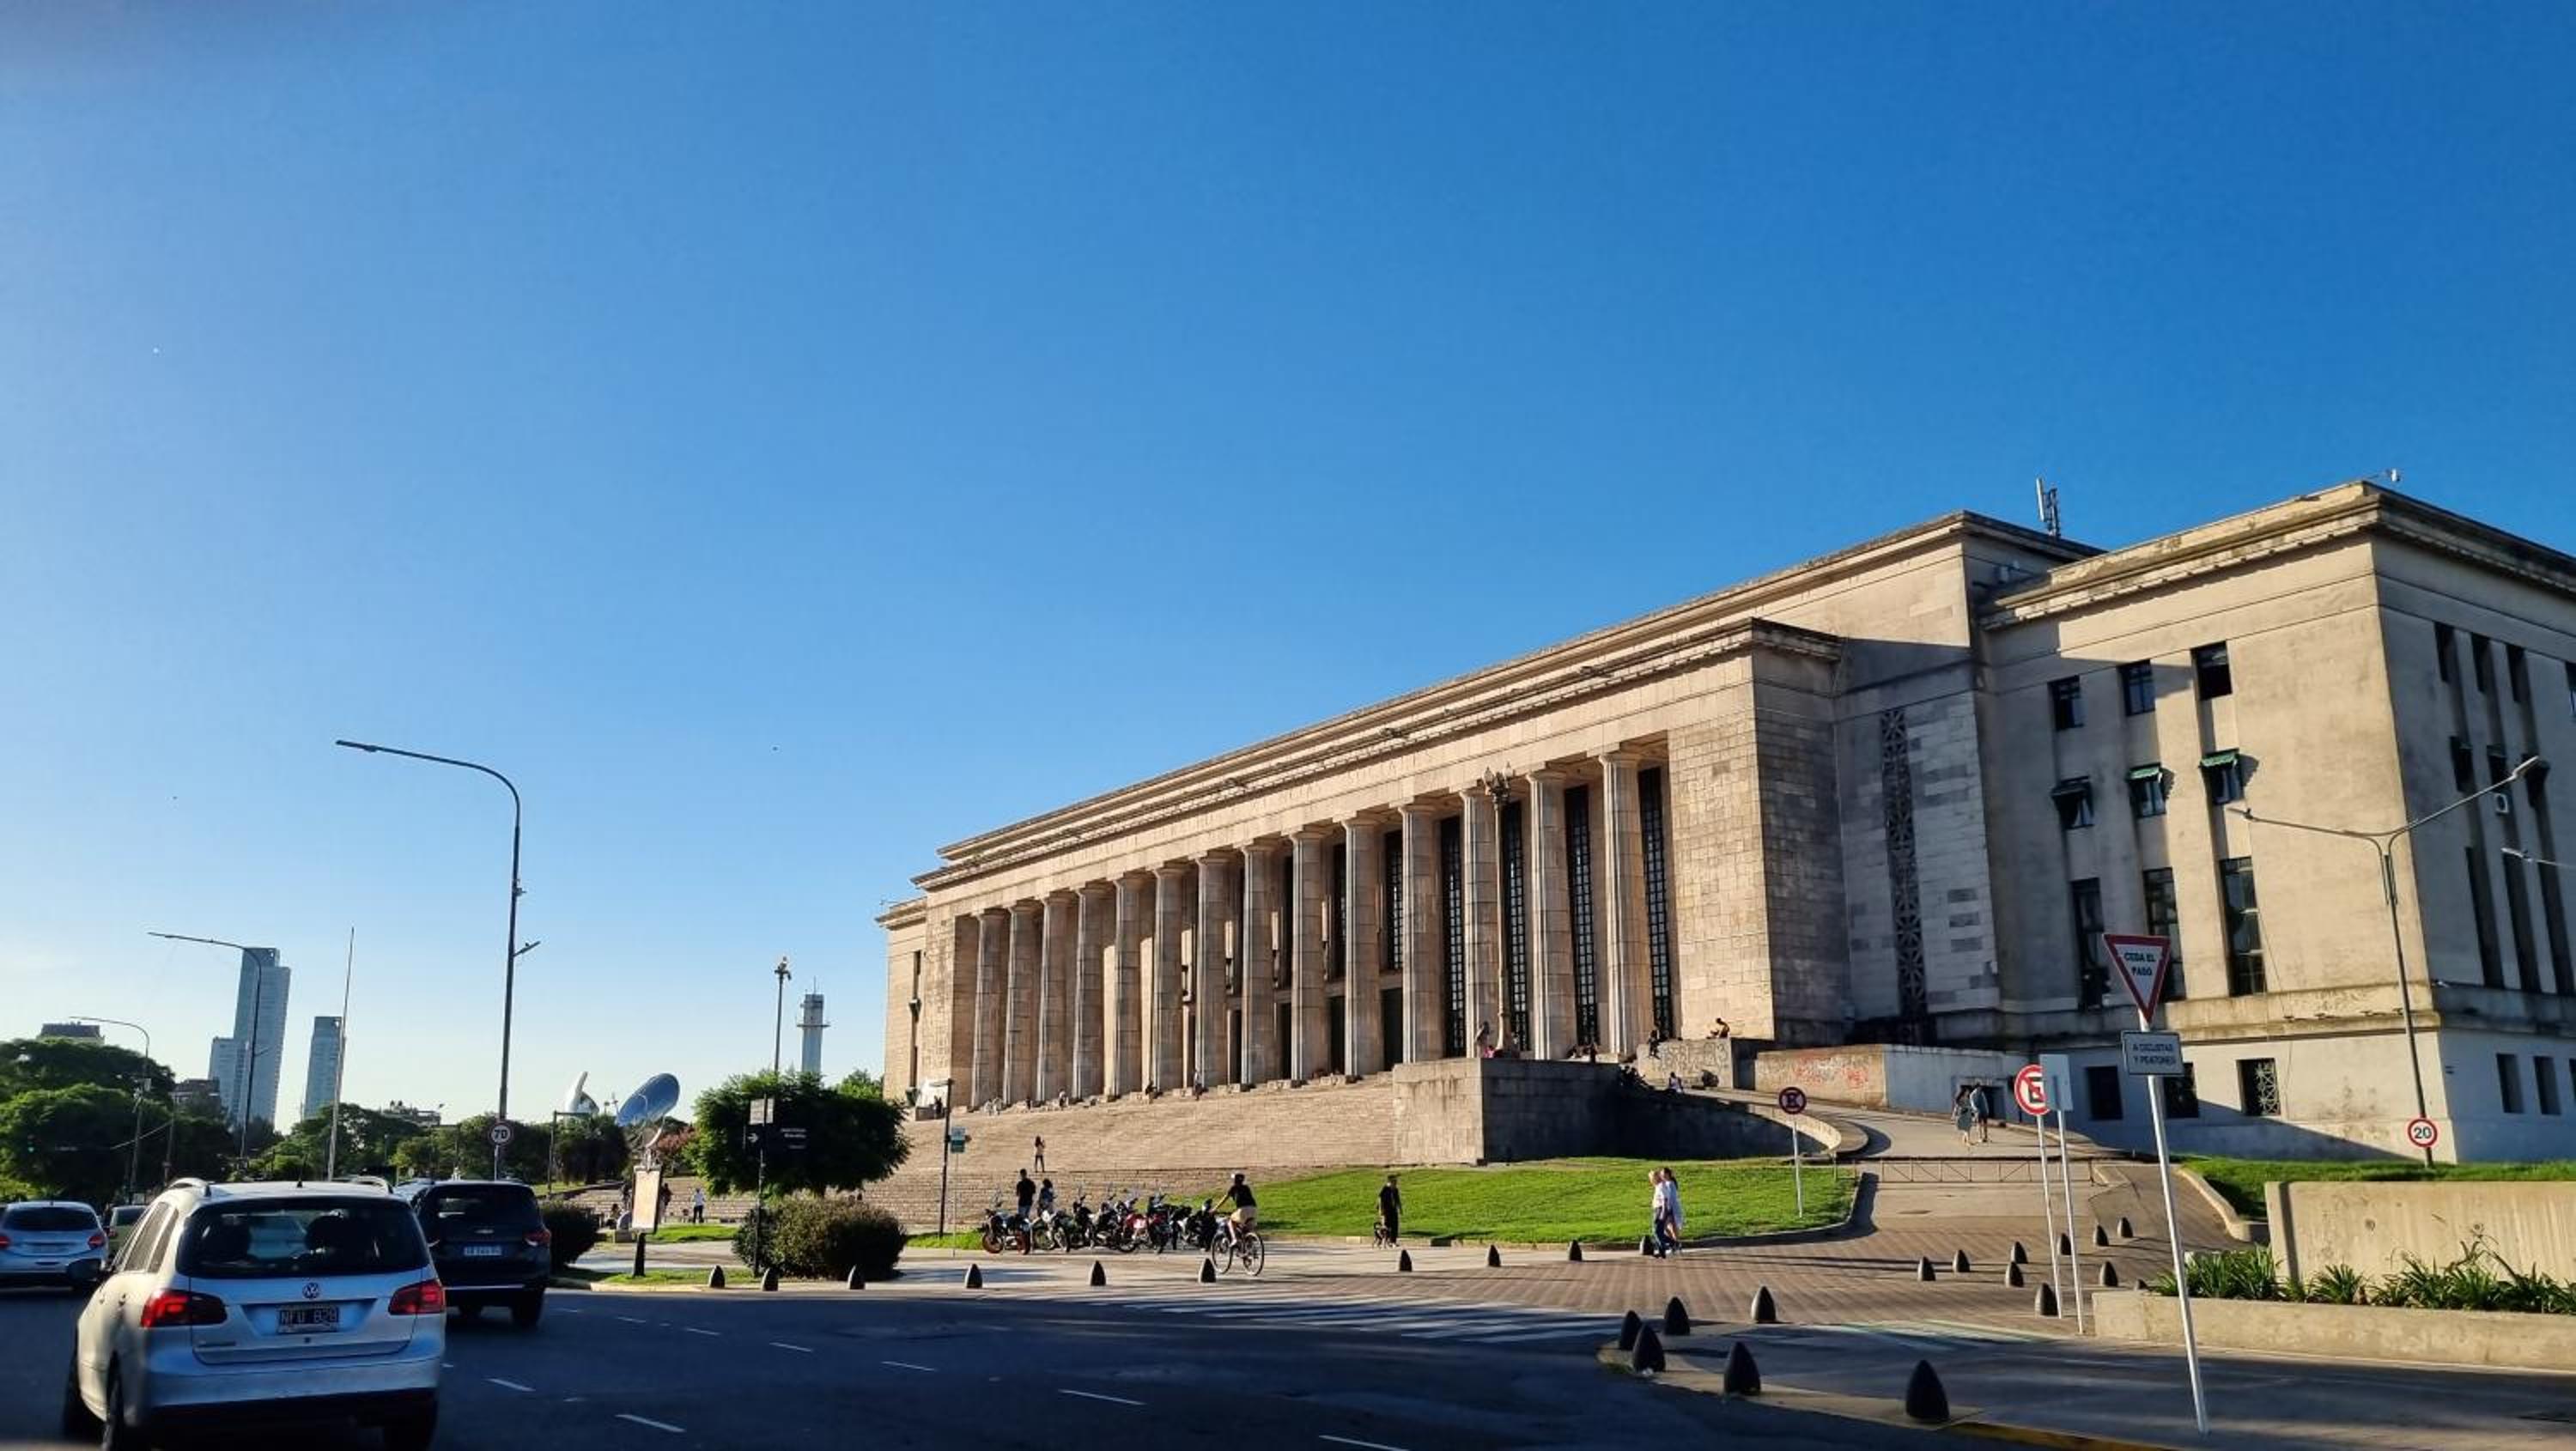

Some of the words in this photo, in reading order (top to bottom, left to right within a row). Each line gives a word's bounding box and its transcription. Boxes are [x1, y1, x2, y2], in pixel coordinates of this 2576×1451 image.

[2123, 952, 2144, 962] CEDA
[2146, 953, 2156, 962] EL
[2131, 967, 2153, 976] PASO
[494, 1129, 507, 1139] 70
[2414, 1126, 2432, 1139] 20
